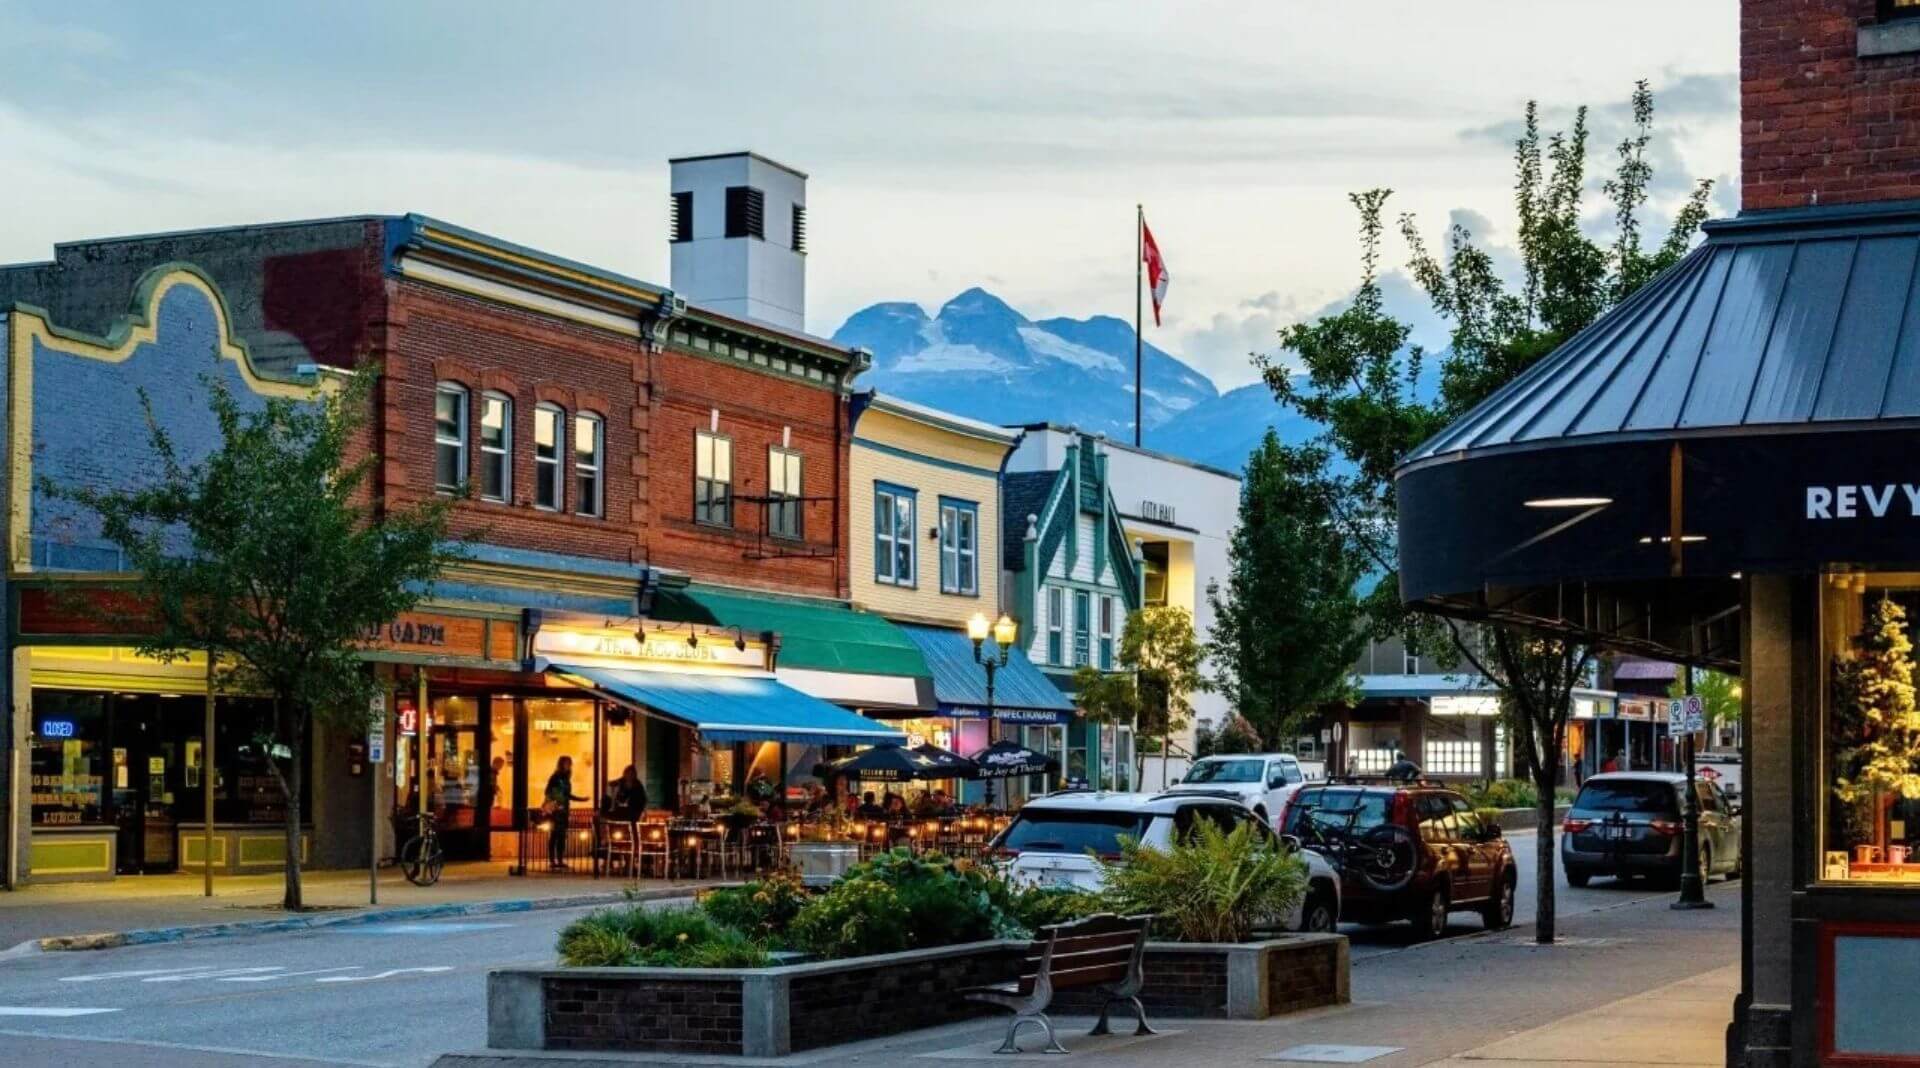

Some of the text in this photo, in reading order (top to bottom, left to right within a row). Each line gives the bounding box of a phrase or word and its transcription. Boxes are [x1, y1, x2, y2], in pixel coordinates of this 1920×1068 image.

[1806, 483, 1920, 519] REVY
[1142, 500, 1175, 523] CITY HALL
[44, 721, 73, 737] CLOSED
[979, 768, 993, 777] The
[43, 812, 81, 824] LUNCH
